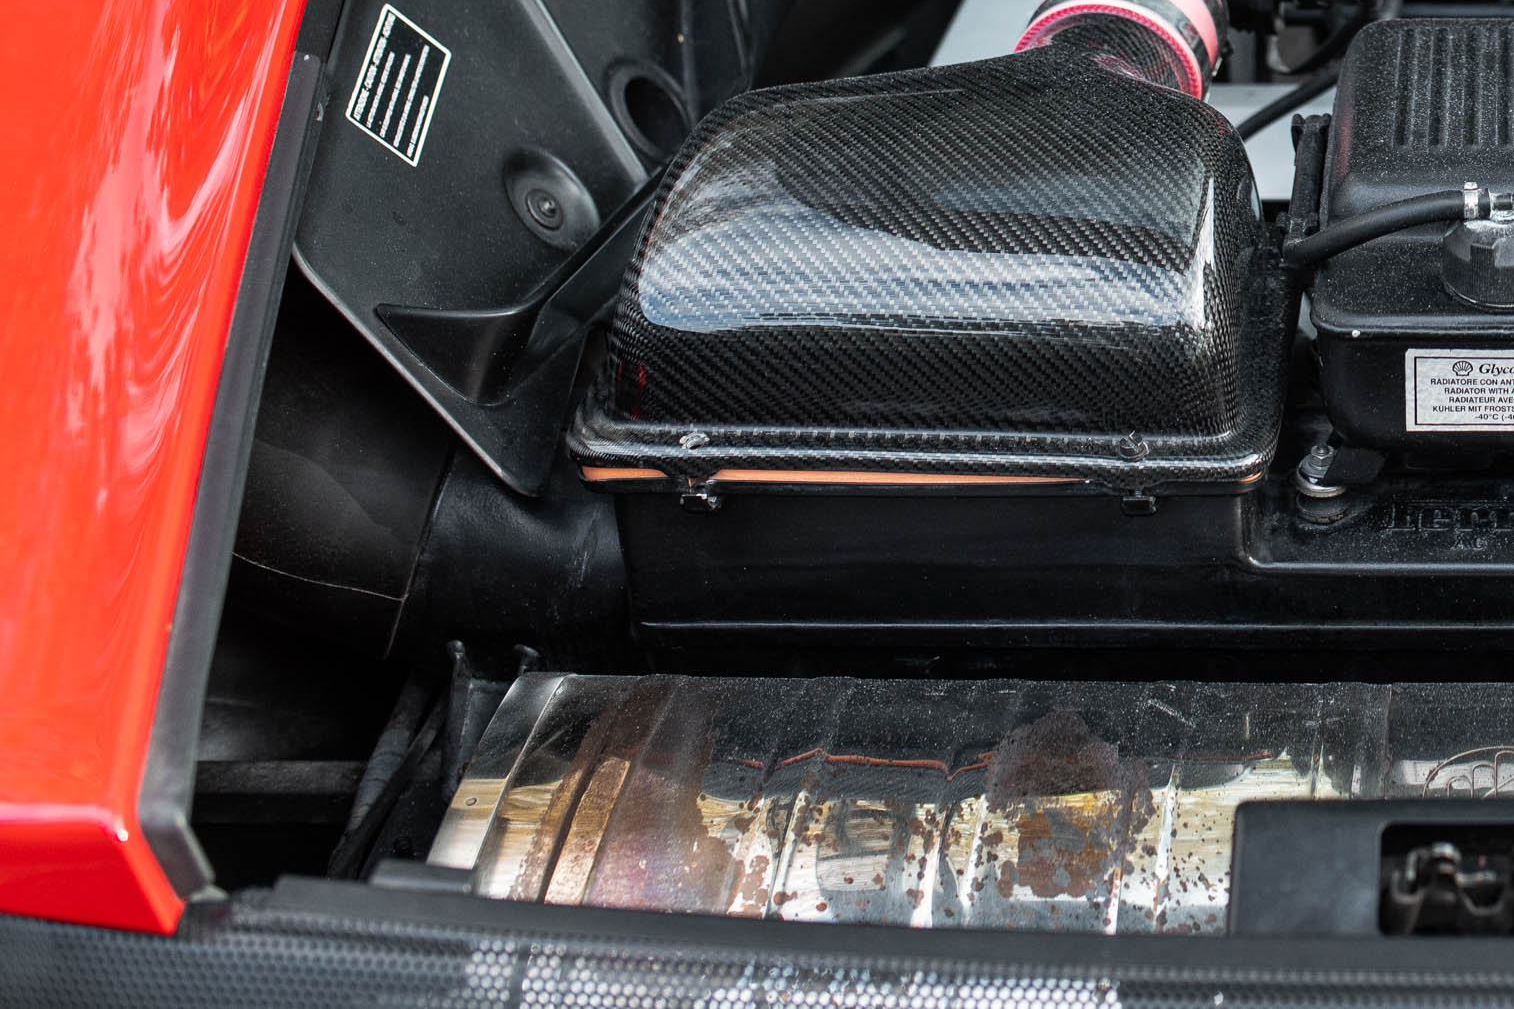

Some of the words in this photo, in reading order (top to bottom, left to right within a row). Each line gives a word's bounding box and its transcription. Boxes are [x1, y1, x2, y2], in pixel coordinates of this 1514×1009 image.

[1430, 378, 1478, 386] RADIATORE
[1479, 378, 1498, 386] CON
[1444, 387, 1487, 395] RADIATOR
[1488, 387, 1509, 395] WITH
[1448, 396, 1496, 404] RADIATEUR
[1468, 405, 1482, 413] MIT
[1474, 413, 1499, 421] -40°C
